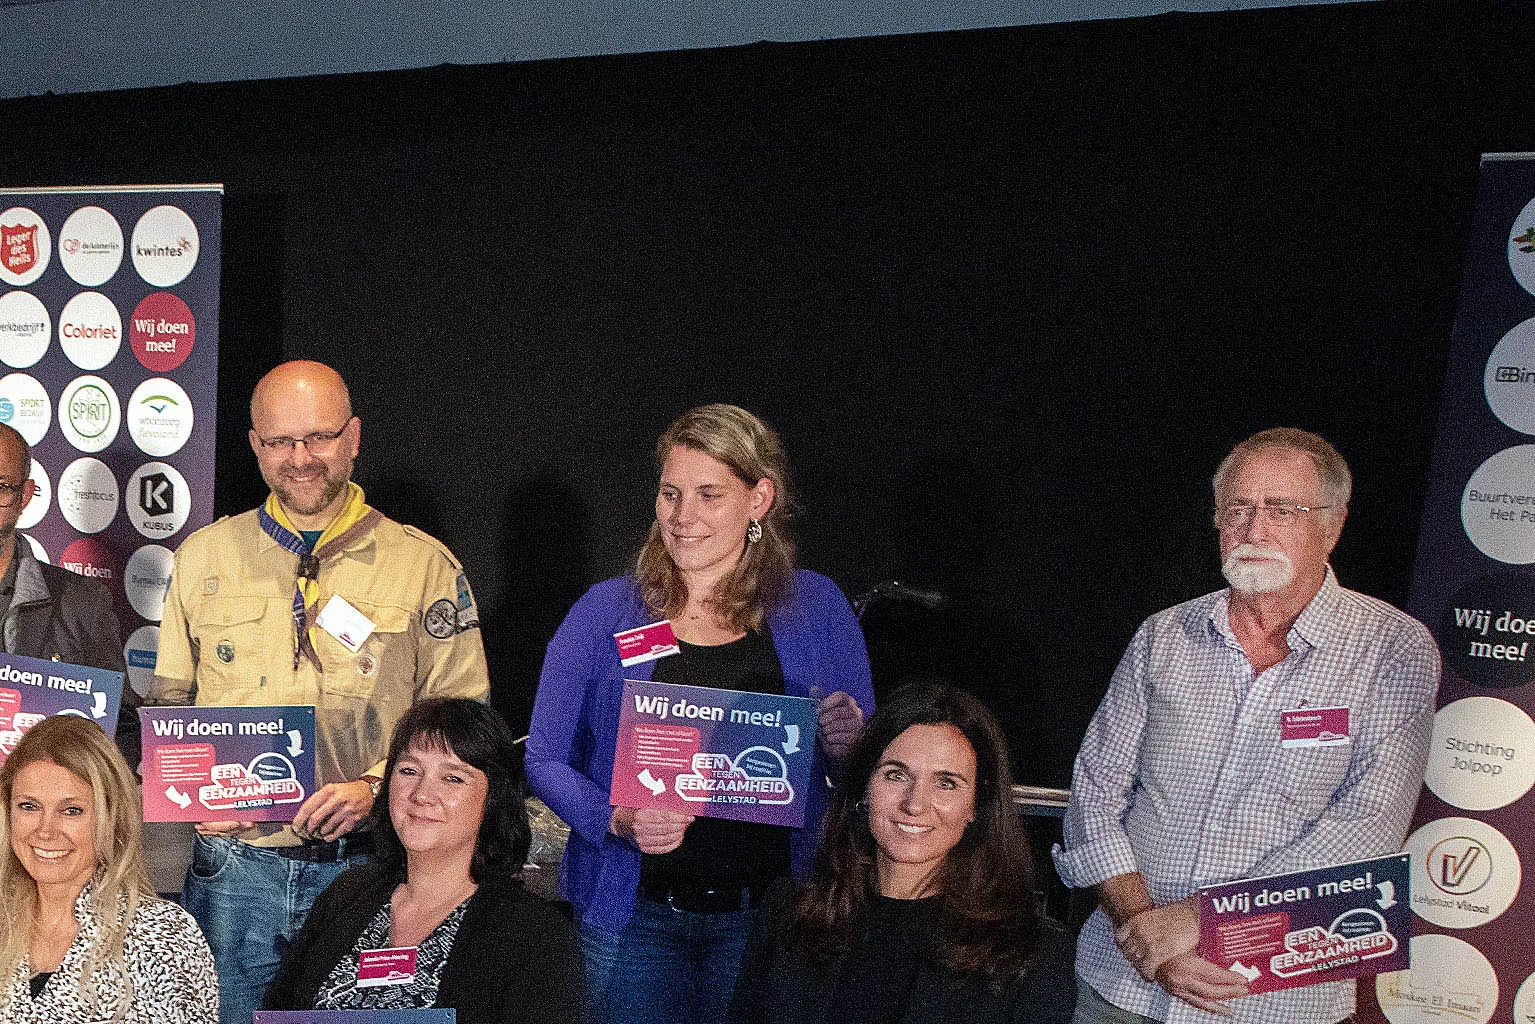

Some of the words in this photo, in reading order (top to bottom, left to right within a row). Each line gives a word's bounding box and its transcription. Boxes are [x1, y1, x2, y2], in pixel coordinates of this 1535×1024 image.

[6, 232, 31, 246] Leger
[136, 244, 183, 257] kwintes
[63, 323, 118, 339] Coloriet
[135, 319, 155, 337] Wij
[157, 320, 189, 335] doen
[145, 339, 176, 354] mee!
[1490, 509, 1515, 521] Het
[143, 521, 174, 531] KUBUS
[85, 562, 112, 578] doen
[1454, 608, 1492, 636] Wij
[1469, 641, 1529, 662] mee!
[47, 676, 92, 694] mee!
[635, 694, 670, 720] Wij
[671, 699, 724, 722] doen
[730, 708, 782, 728] mee!
[152, 718, 183, 740] Wij
[187, 719, 233, 735] doen
[238, 719, 284, 735] mee!
[1445, 737, 1515, 761] Stichting
[695, 757, 724, 770] EEN
[216, 767, 240, 779] EEN
[711, 770, 740, 779] TEGEN
[203, 781, 296, 800] EENZAAMHEID
[678, 778, 785, 794] EENZAAMHEID
[712, 795, 756, 804] LELYSTAD
[1212, 892, 1250, 914] Wij
[1254, 886, 1312, 908] doen
[1317, 872, 1372, 898] mee!
[1289, 930, 1319, 946] EEN
[1274, 933, 1388, 969] EENZAAMHEID
